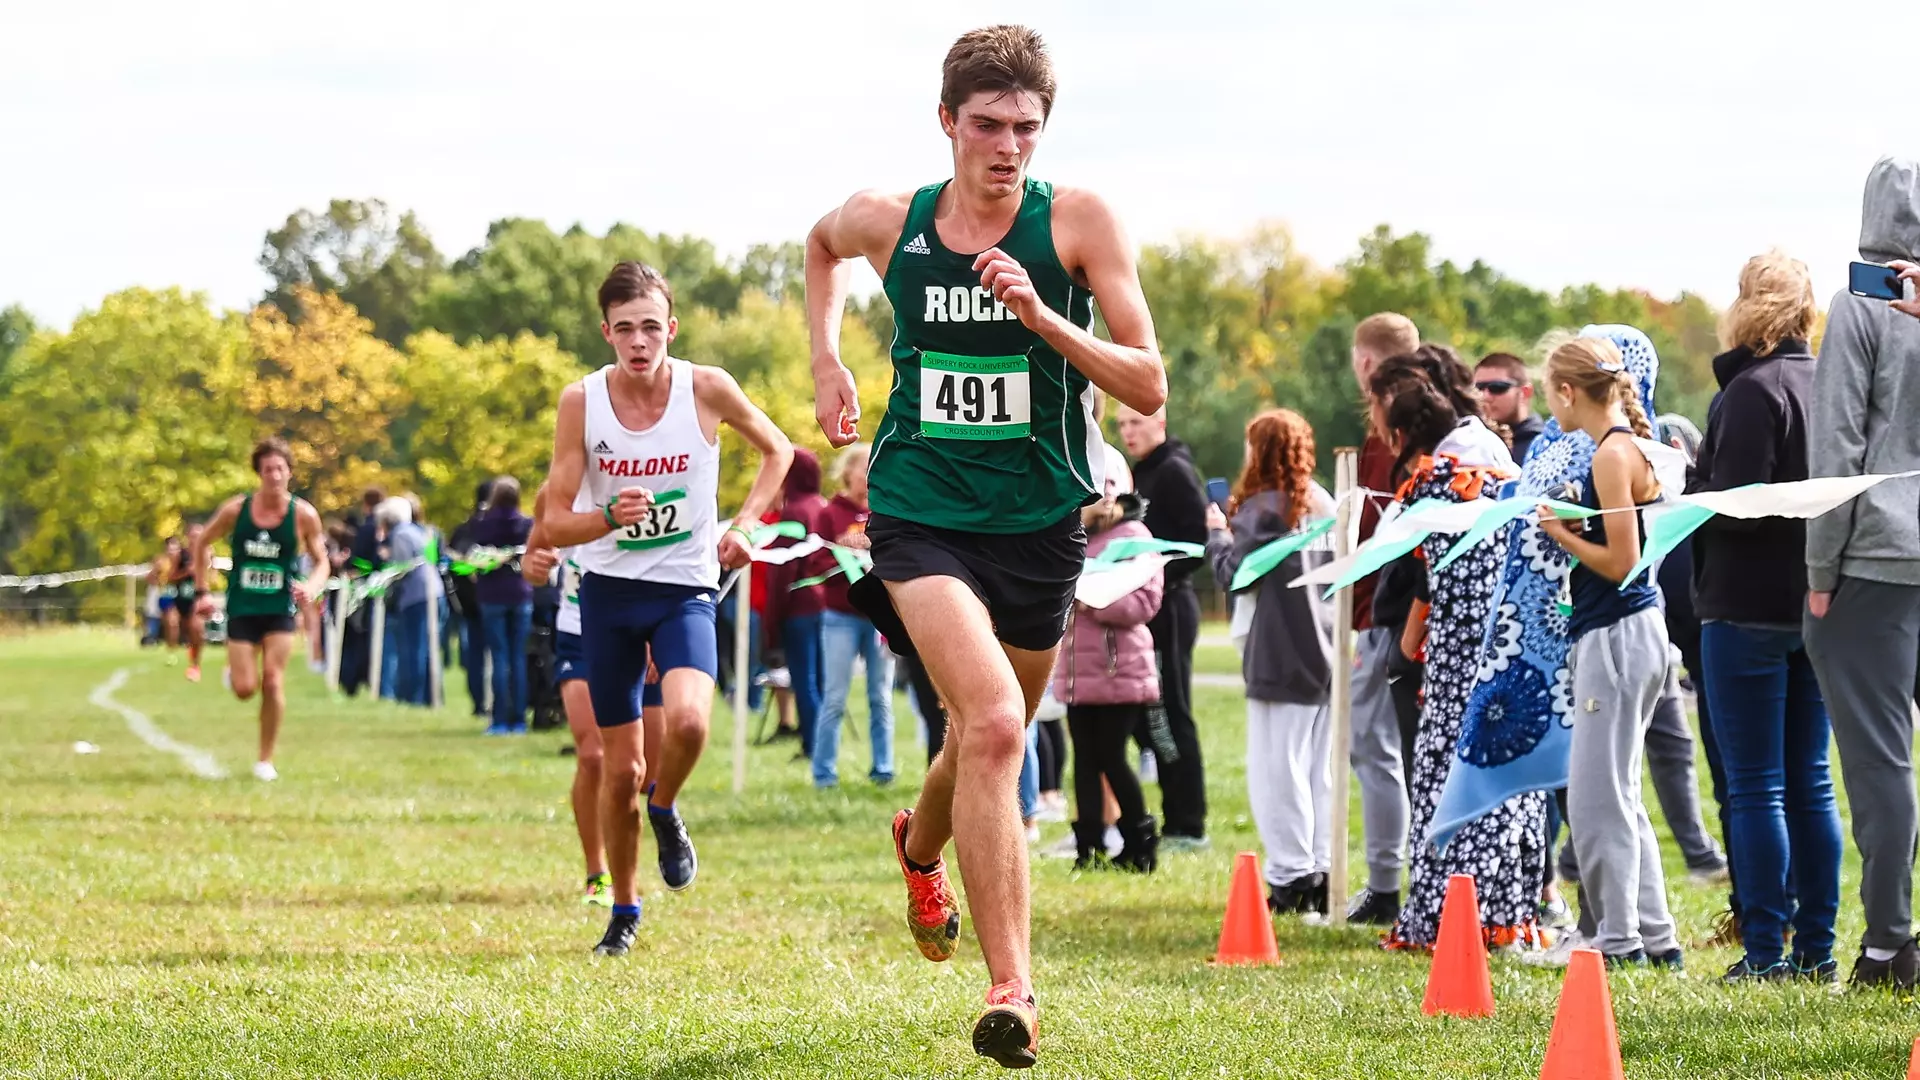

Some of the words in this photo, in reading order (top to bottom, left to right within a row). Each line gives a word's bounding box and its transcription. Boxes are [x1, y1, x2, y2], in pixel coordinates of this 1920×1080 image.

[903, 243, 931, 255] adidas
[928, 358, 957, 368] SLIPPERY
[958, 361, 977, 369] ROCK
[979, 361, 1020, 370] UNIVERSITY
[935, 374, 1012, 423] 491
[944, 427, 968, 435] CROSS
[969, 428, 1005, 436] COUNTRY
[598, 453, 690, 477] MALONE
